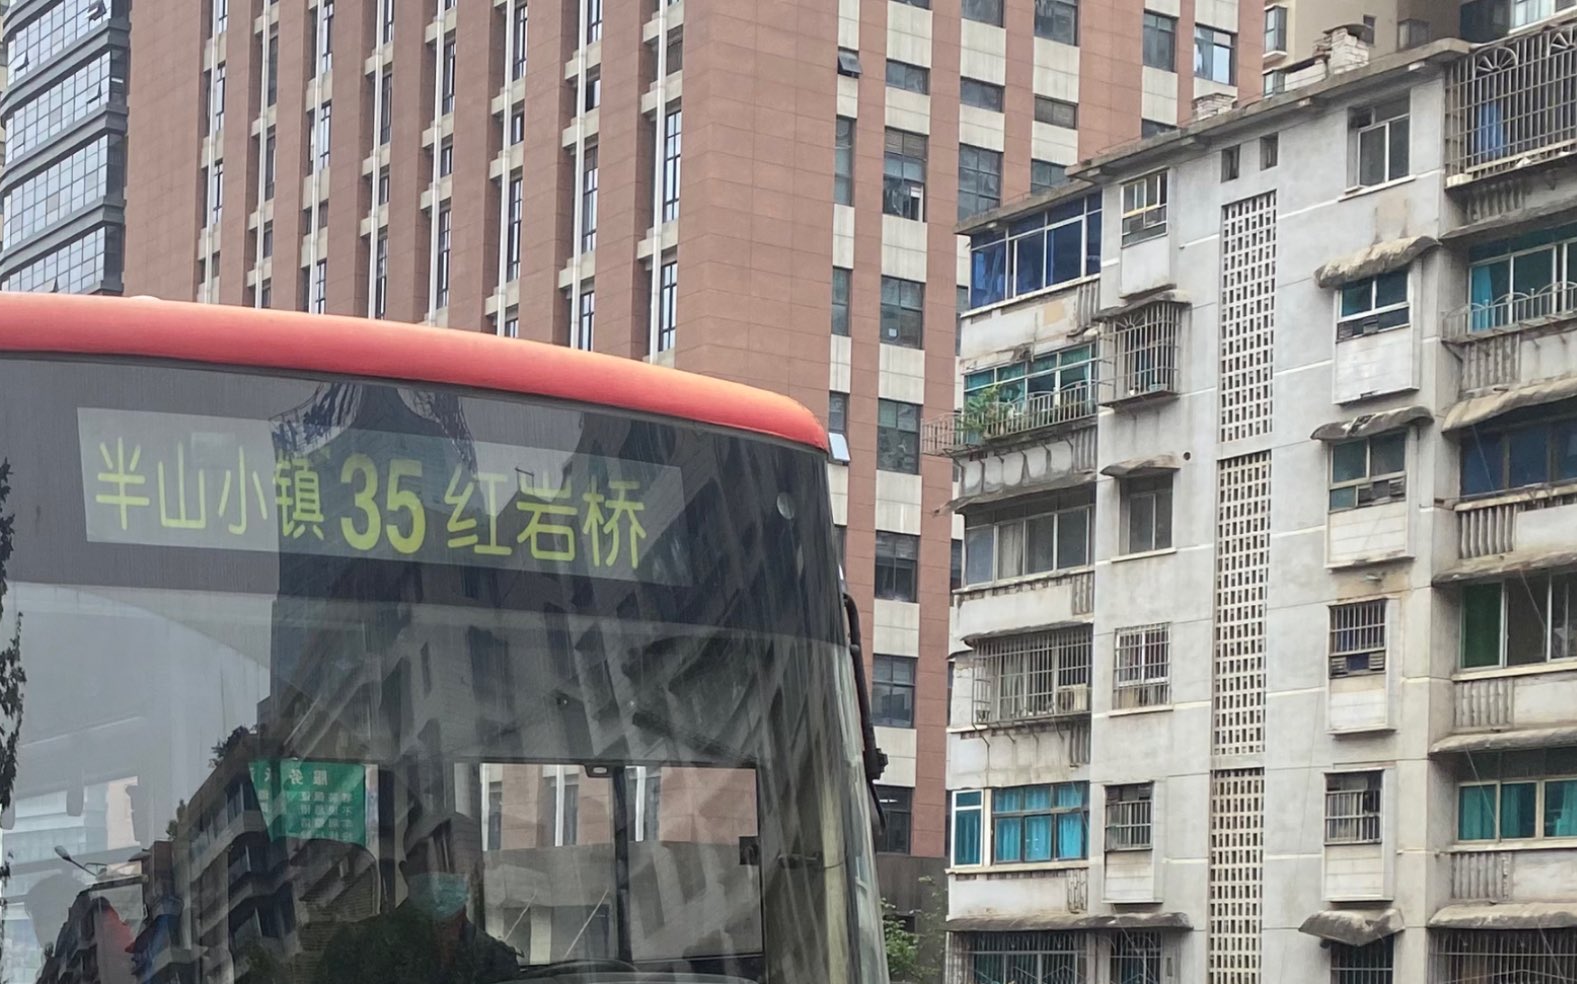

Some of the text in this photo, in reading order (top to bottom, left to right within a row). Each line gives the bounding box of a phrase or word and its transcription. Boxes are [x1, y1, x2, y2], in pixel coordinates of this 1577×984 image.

[95, 436, 647, 570] 半山小镇 35 红岩桥
